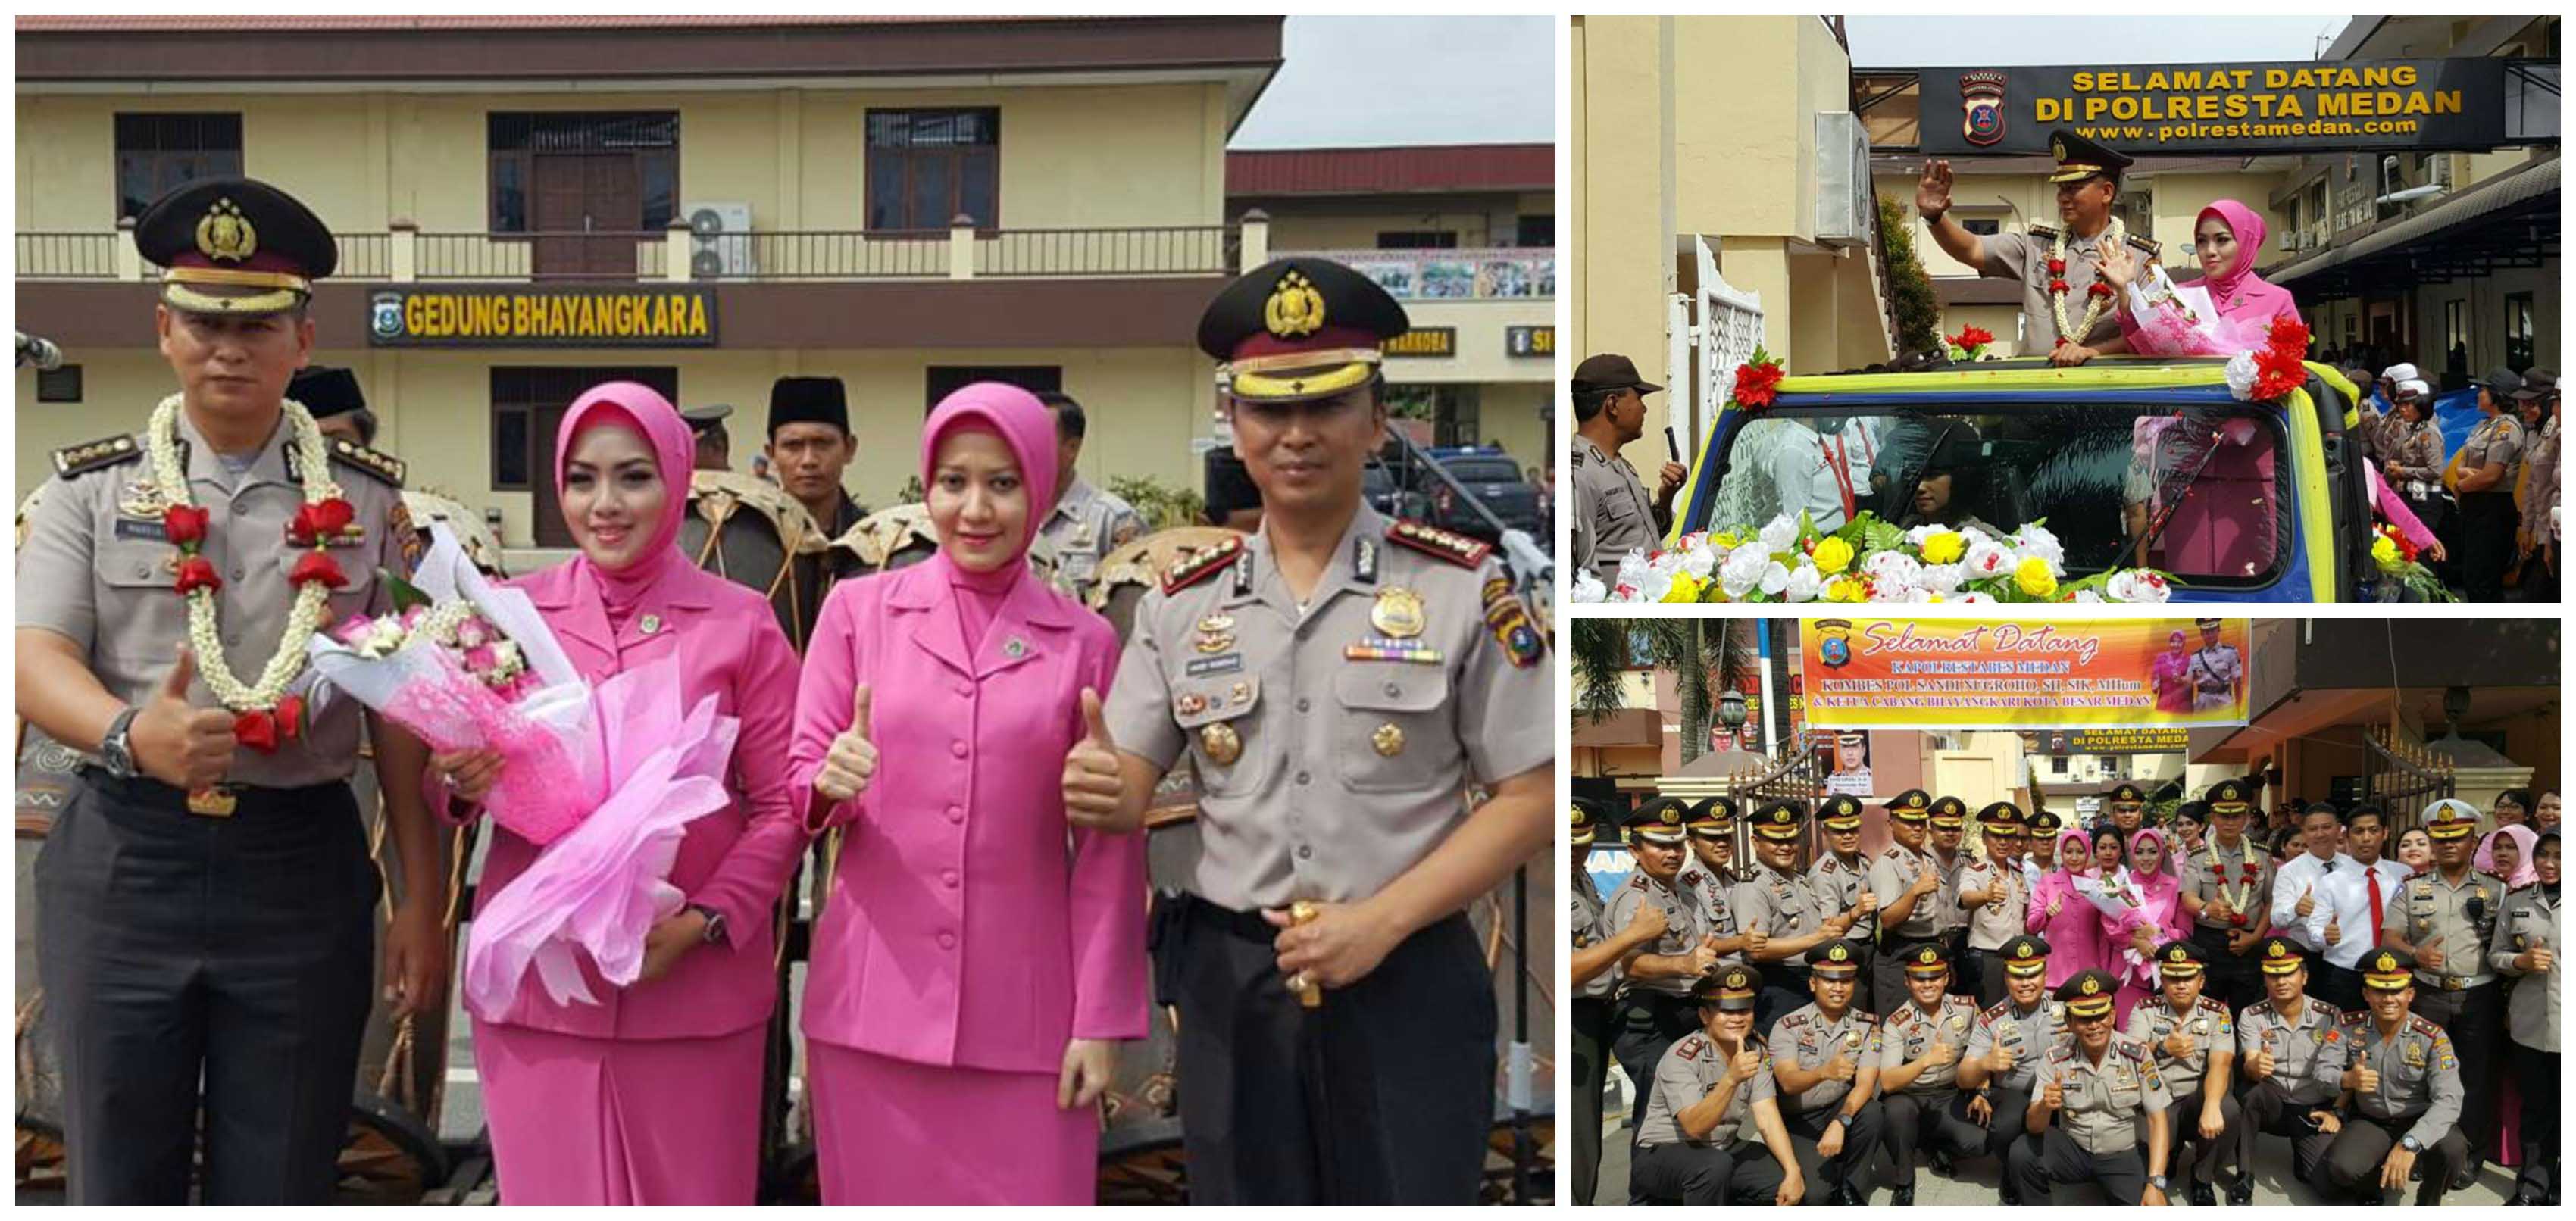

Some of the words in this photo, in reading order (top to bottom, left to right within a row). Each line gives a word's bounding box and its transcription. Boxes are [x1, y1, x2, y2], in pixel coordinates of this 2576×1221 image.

[2072, 70, 2253, 92] SELAMAT
[2265, 66, 2418, 89] DATANG
[2036, 98, 2073, 121] DI
[2086, 94, 2303, 120] POLRESTA
[2317, 90, 2461, 117] MEDAN
[2075, 119, 2417, 142] www.polrestamedan.com
[405, 295, 508, 336] GEDUNG
[513, 295, 707, 336] BHAYANGKARA
[1864, 622, 1988, 655] Selamat
[1993, 624, 2099, 664] Datang
[2018, 661, 2070, 673] MEDAN
[1823, 679, 1883, 692] KOMBES
[1918, 679, 1962, 692] SANDI
[1813, 697, 1822, 707] &
[1827, 697, 1869, 707] KETUA
[1872, 697, 1924, 707] CABANG
[1927, 696, 2020, 707] BHAYANGKARI
[2024, 696, 2059, 707] KOTA
[2063, 696, 2102, 707] BESAR
[2106, 695, 2151, 707] MEDAN
[2073, 737, 2084, 745] DI
[2087, 735, 2153, 745] POLRESTA
[2156, 735, 2189, 743] MEDA
[2084, 728, 2137, 736] SELAMAT
